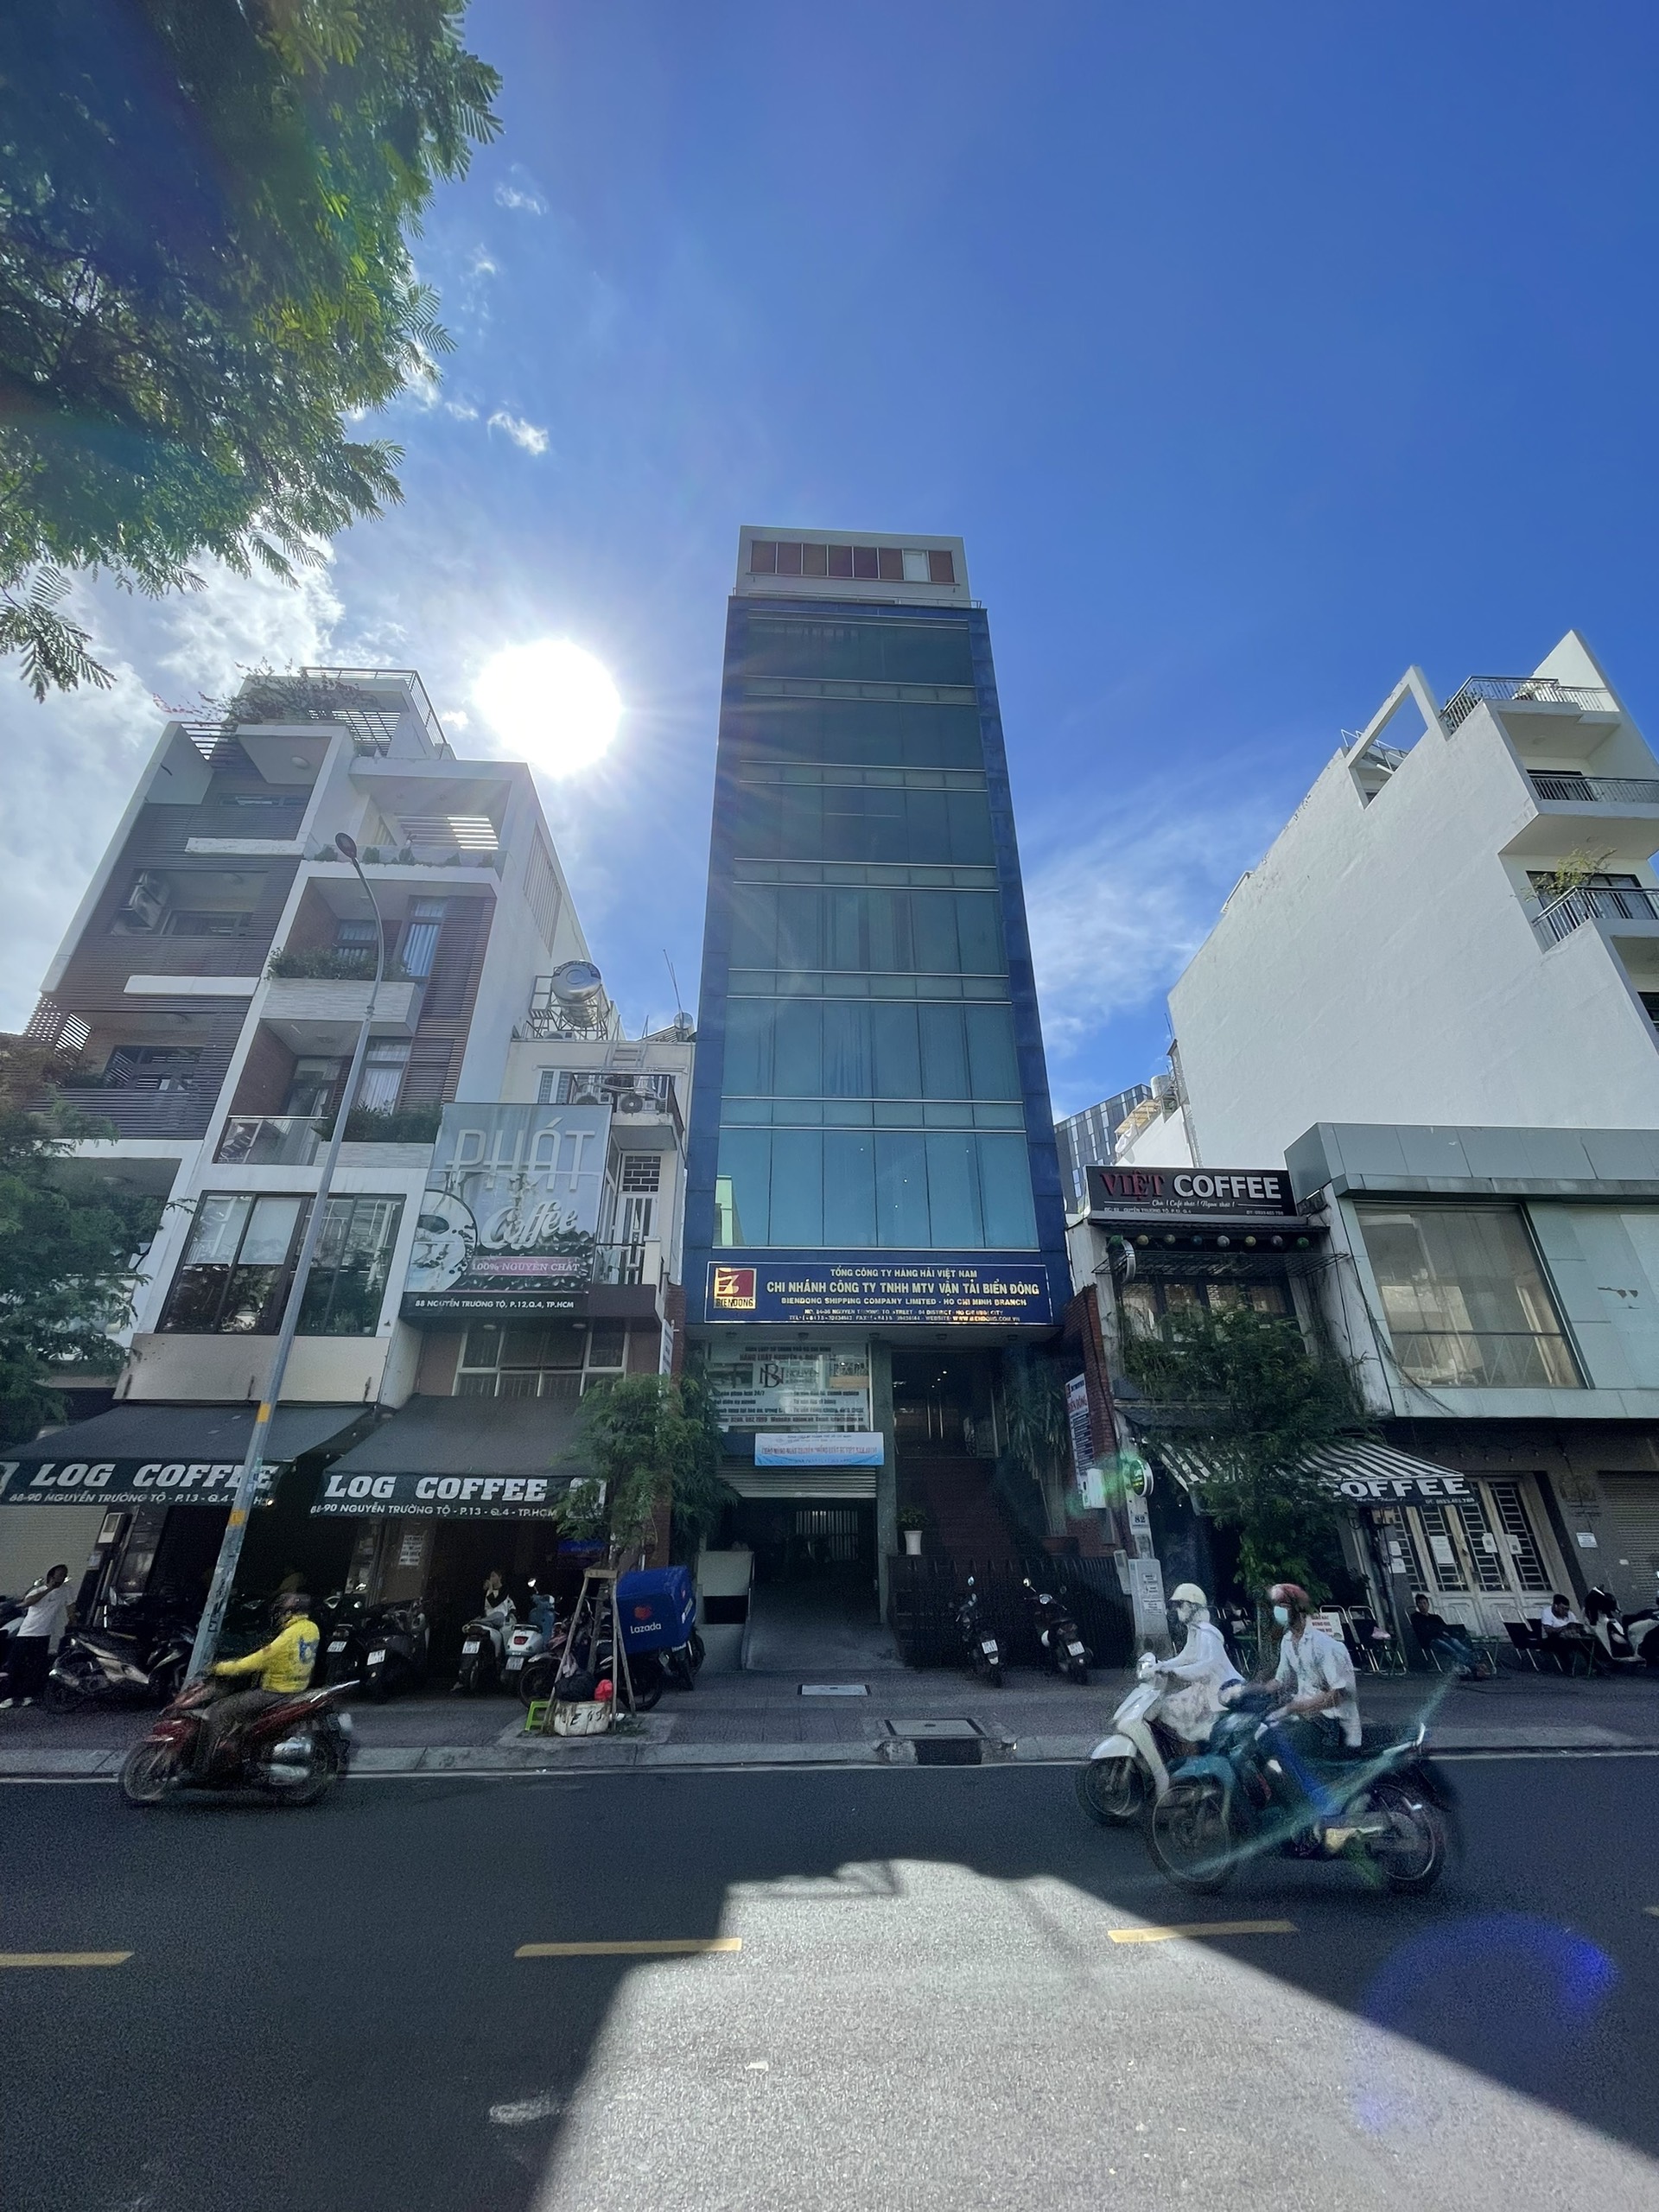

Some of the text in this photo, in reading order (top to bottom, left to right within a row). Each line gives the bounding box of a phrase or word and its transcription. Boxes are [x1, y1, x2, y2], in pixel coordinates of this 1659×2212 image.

[446, 1117, 595, 1192] PHÁT
[1099, 1169, 1281, 1201] VIỆT COFFEE
[480, 1199, 579, 1250] Coffee
[472, 1262, 499, 1271] 100%
[830, 1265, 977, 1280] TỔNG CÔNG TY HÀNG HẢI VIỆT NAM
[766, 1278, 1039, 1296] CHI NHÁNH CÔNG TY TNHH MTV VẬN TẢI BIỂN ĐÔNG
[715, 1298, 754, 1307] BIENDONG
[29, 1463, 117, 1487] LOG
[324, 1475, 548, 1502] LOG COFFEE
[1334, 1478, 1471, 1498] OFFEE
[175, 1494, 199, 1503] P.13
[207, 1494, 229, 1503] Q.4
[340, 1502, 385, 1513] NGUYỄN
[388, 1503, 433, 1514] TRƯỜNG
[436, 1505, 451, 1516] TỘ
[630, 1622, 662, 1634] Lazada
